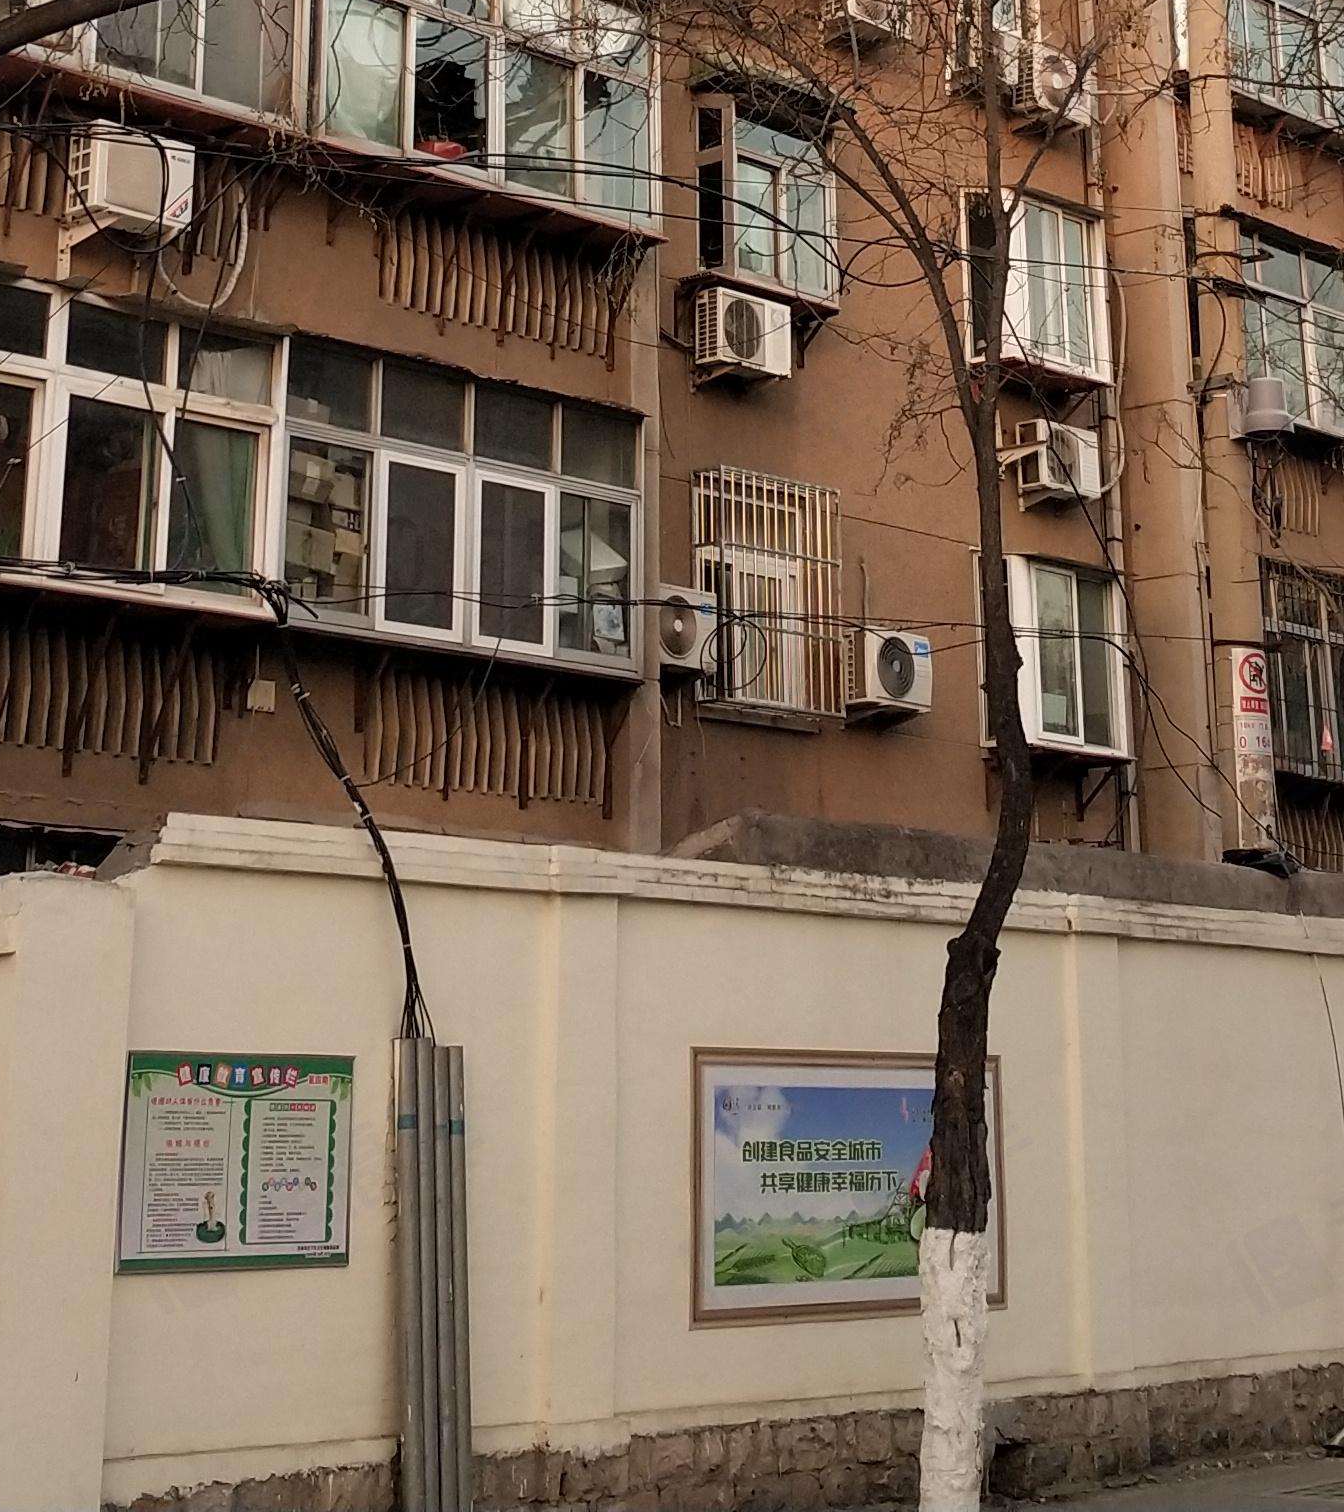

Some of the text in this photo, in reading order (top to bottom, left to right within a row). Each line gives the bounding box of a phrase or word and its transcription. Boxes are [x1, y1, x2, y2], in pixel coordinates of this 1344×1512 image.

[742, 1140, 883, 1162] 创建食品安全城市
[759, 1171, 899, 1194] 共享健康幸福历下
